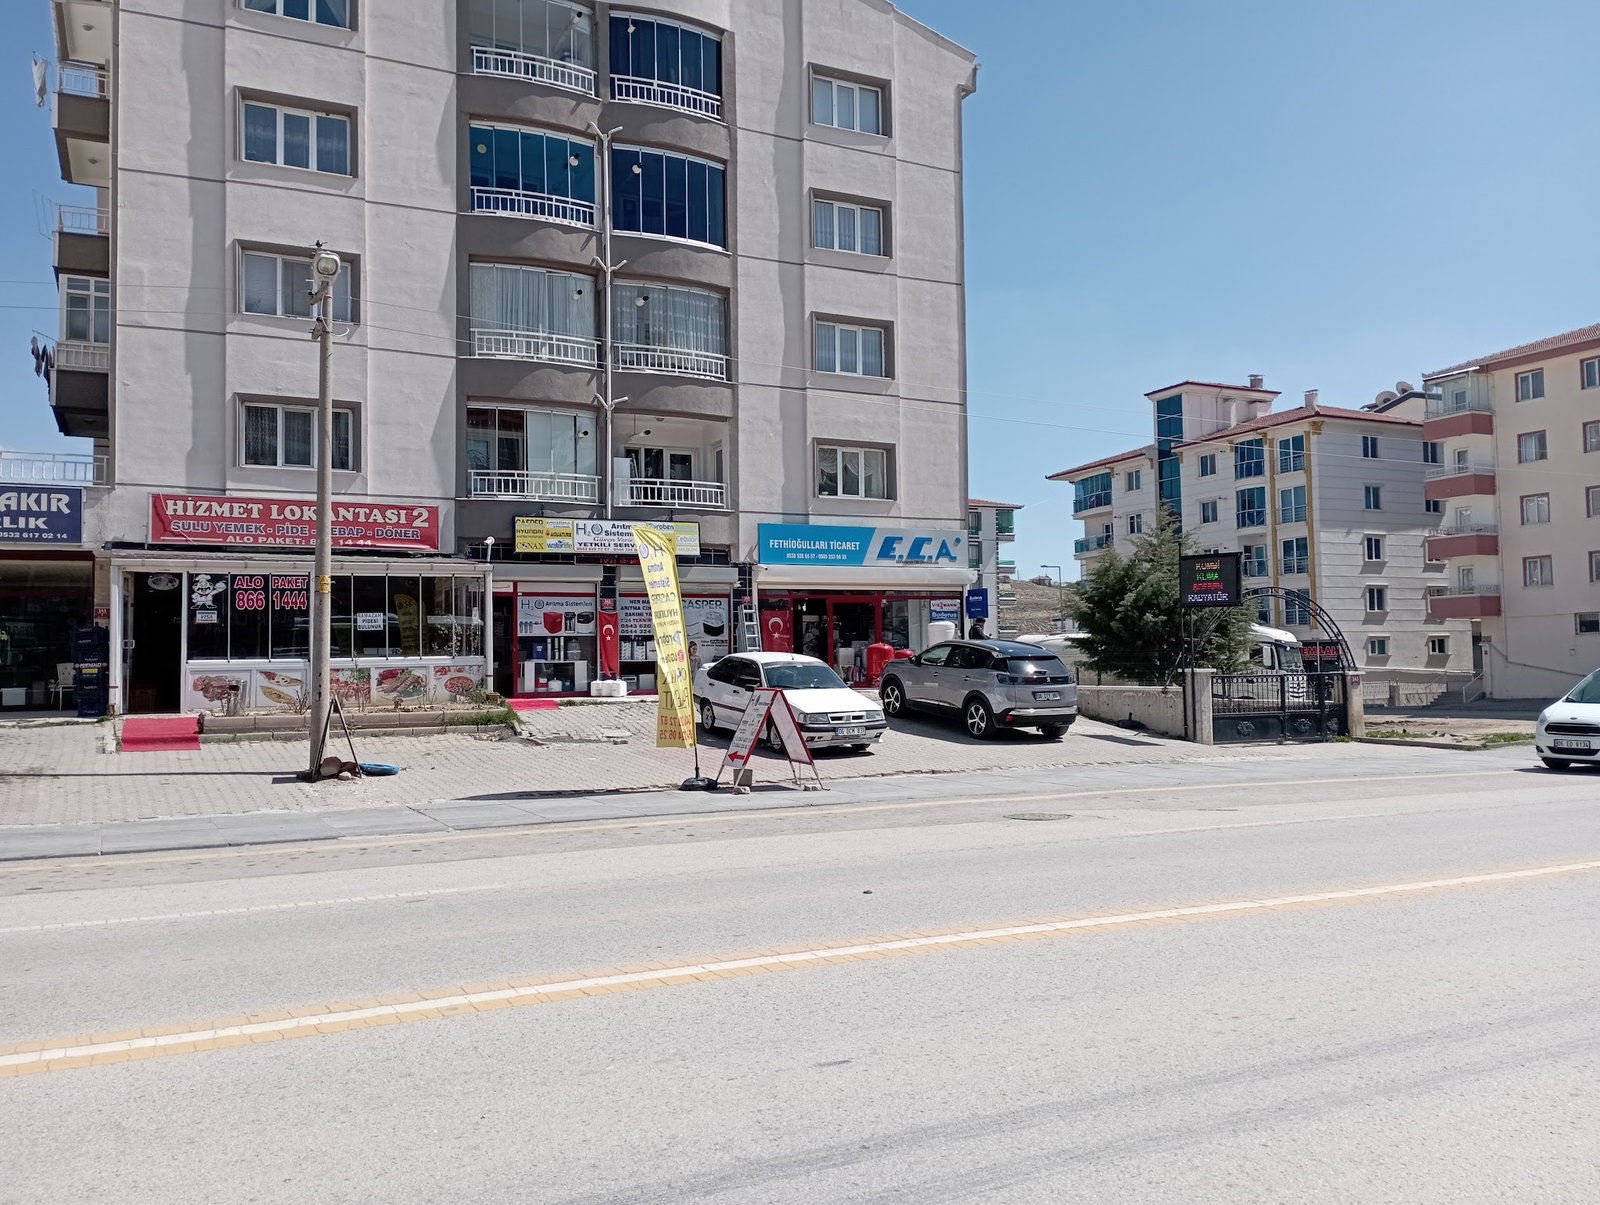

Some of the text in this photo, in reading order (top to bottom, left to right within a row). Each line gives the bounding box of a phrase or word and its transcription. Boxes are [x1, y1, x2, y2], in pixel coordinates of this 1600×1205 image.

[0, 492, 71, 515] AKIR
[165, 497, 263, 518] HİZMET
[412, 508, 429, 527] 2
[0, 516, 48, 529] LIK
[171, 520, 211, 532] SULU
[214, 522, 265, 535] YEMEK
[276, 522, 309, 536] PİDE
[331, 526, 365, 537] EBAP
[375, 526, 420, 539] DÖNER
[769, 538, 860, 551] FETHİOĞULLARI TİCARET
[234, 576, 264, 589] ALO
[272, 576, 308, 589] PAKET
[235, 590, 307, 610] 866 1444
